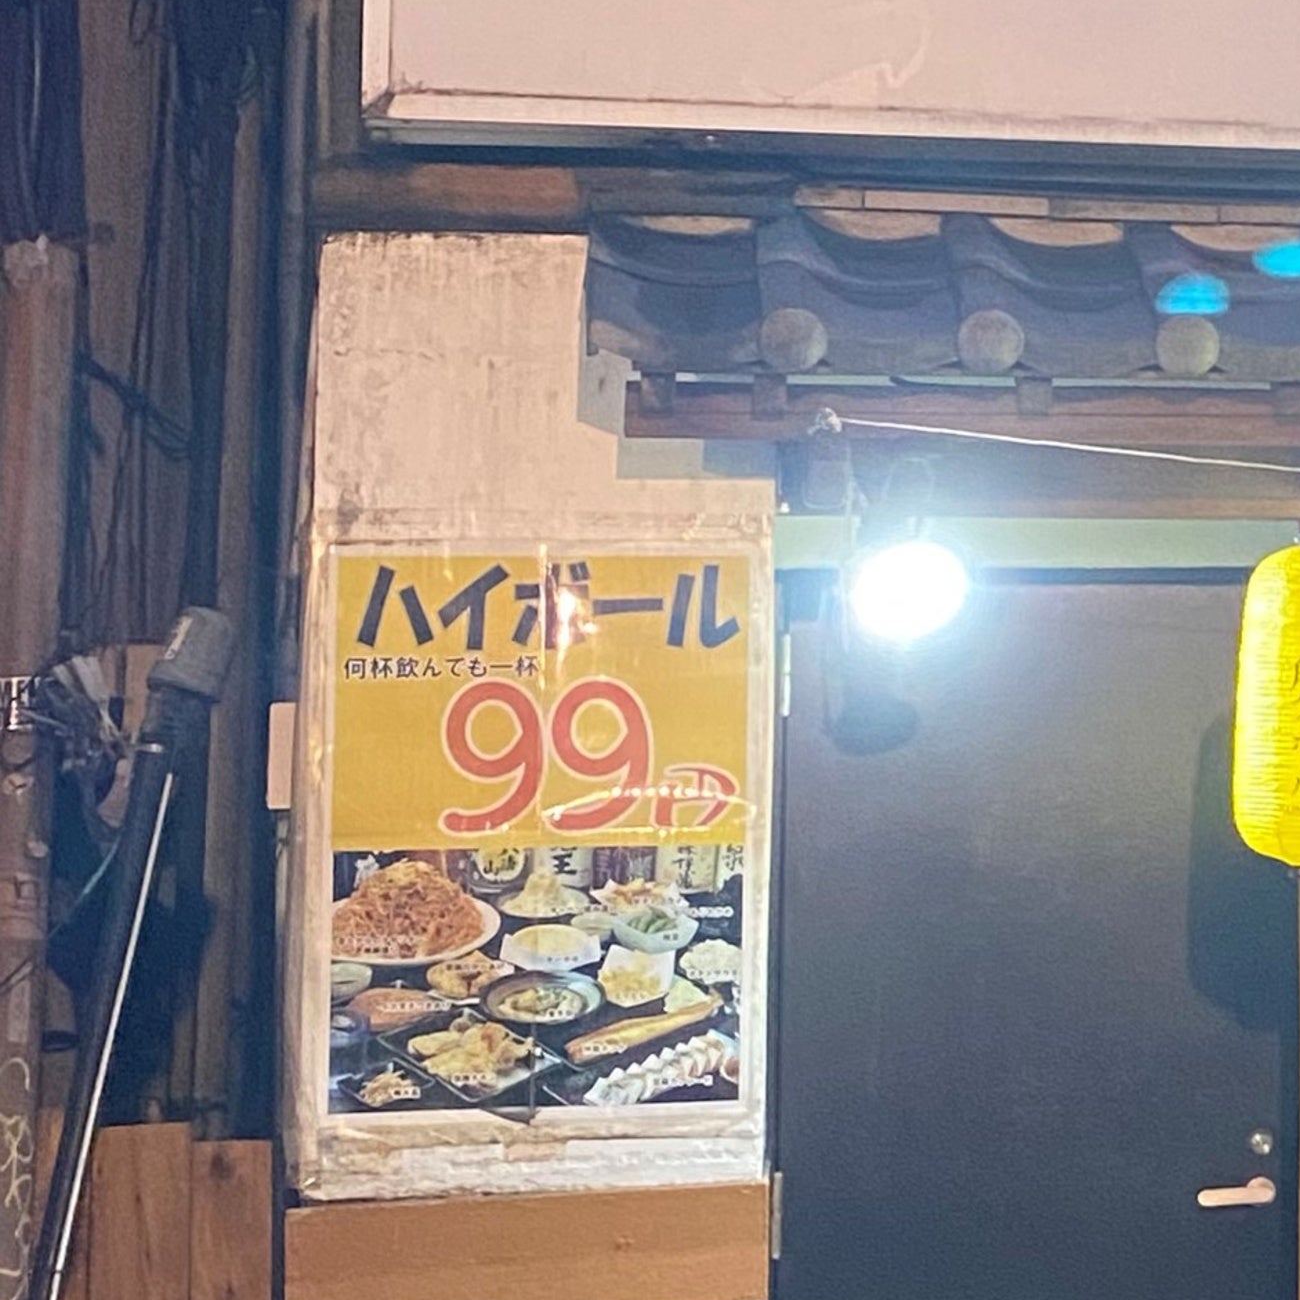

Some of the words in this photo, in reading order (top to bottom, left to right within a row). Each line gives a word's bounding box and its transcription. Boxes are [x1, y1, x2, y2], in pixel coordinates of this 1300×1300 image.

[343, 655, 539, 680] 何杯飲んでも一杯
